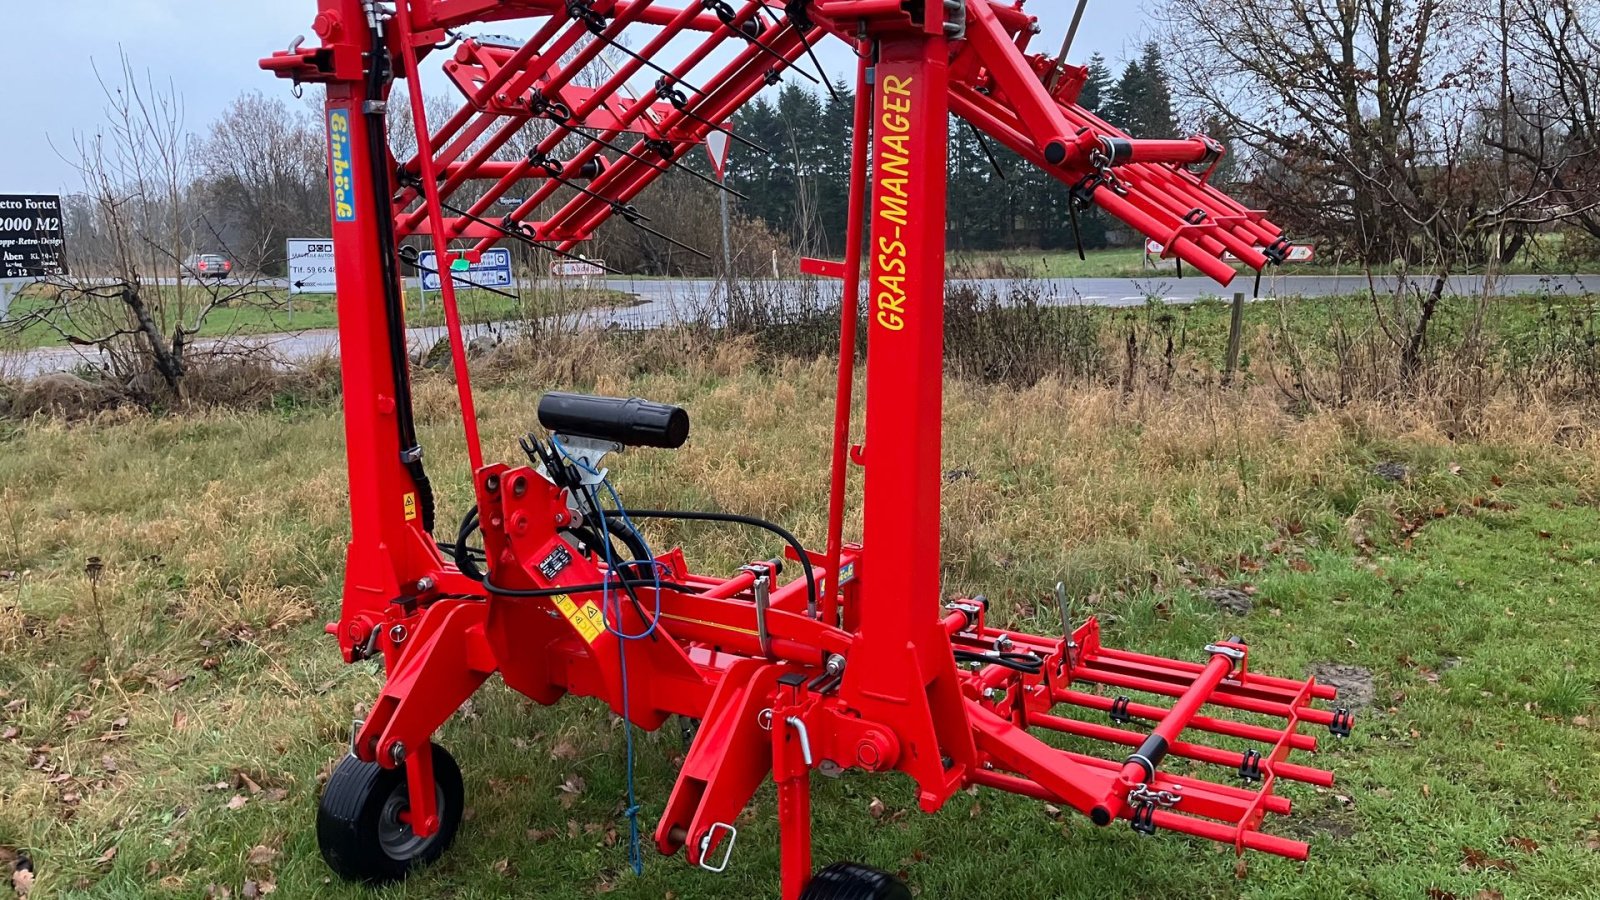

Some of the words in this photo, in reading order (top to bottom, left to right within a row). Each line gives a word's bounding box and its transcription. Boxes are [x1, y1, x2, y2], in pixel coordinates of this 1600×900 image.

[331, 113, 352, 218] Einböck
[0, 200, 23, 209] etro
[25, 198, 57, 209] Fortet
[35, 217, 59, 231] M2
[876, 75, 913, 331] GRASS-MANAGER
